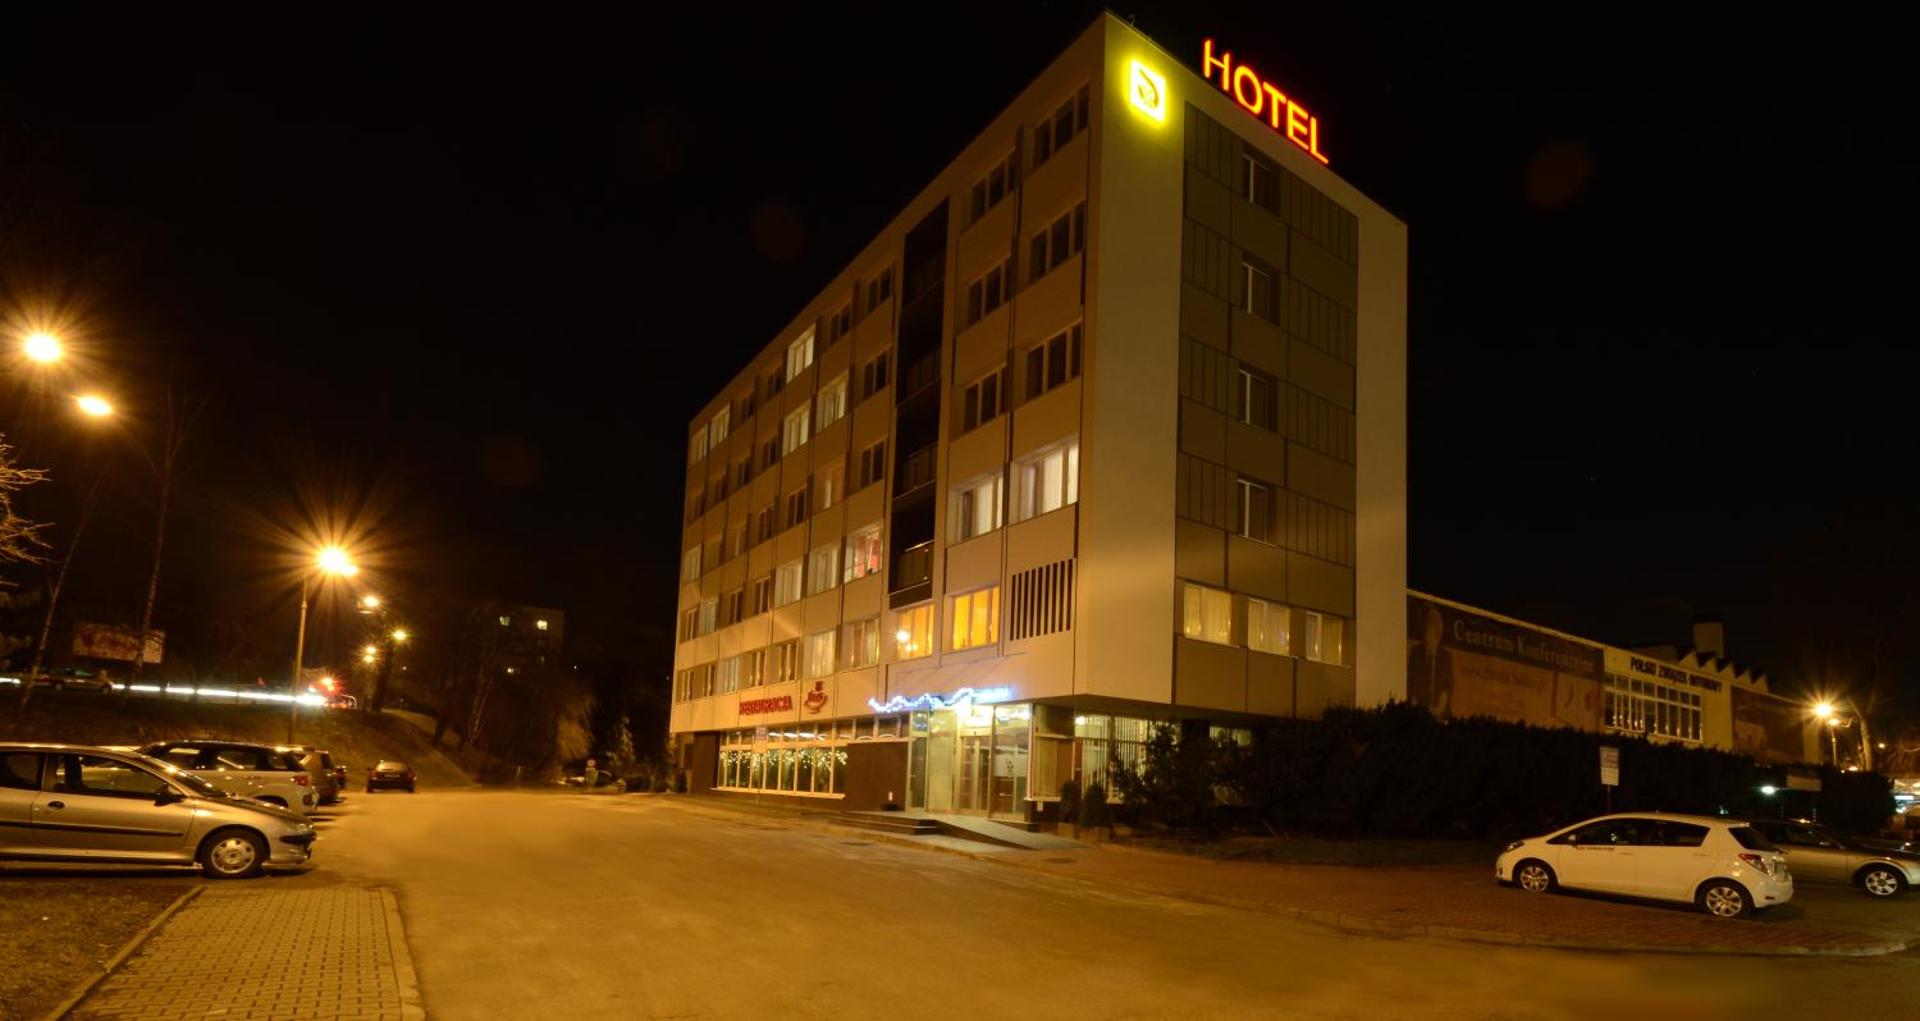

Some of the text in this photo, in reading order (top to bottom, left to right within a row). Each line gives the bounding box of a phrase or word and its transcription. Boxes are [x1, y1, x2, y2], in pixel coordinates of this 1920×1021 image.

[1204, 39, 1329, 165] HOTEL
[1454, 620, 1595, 673] Centrum Konferencyjne
